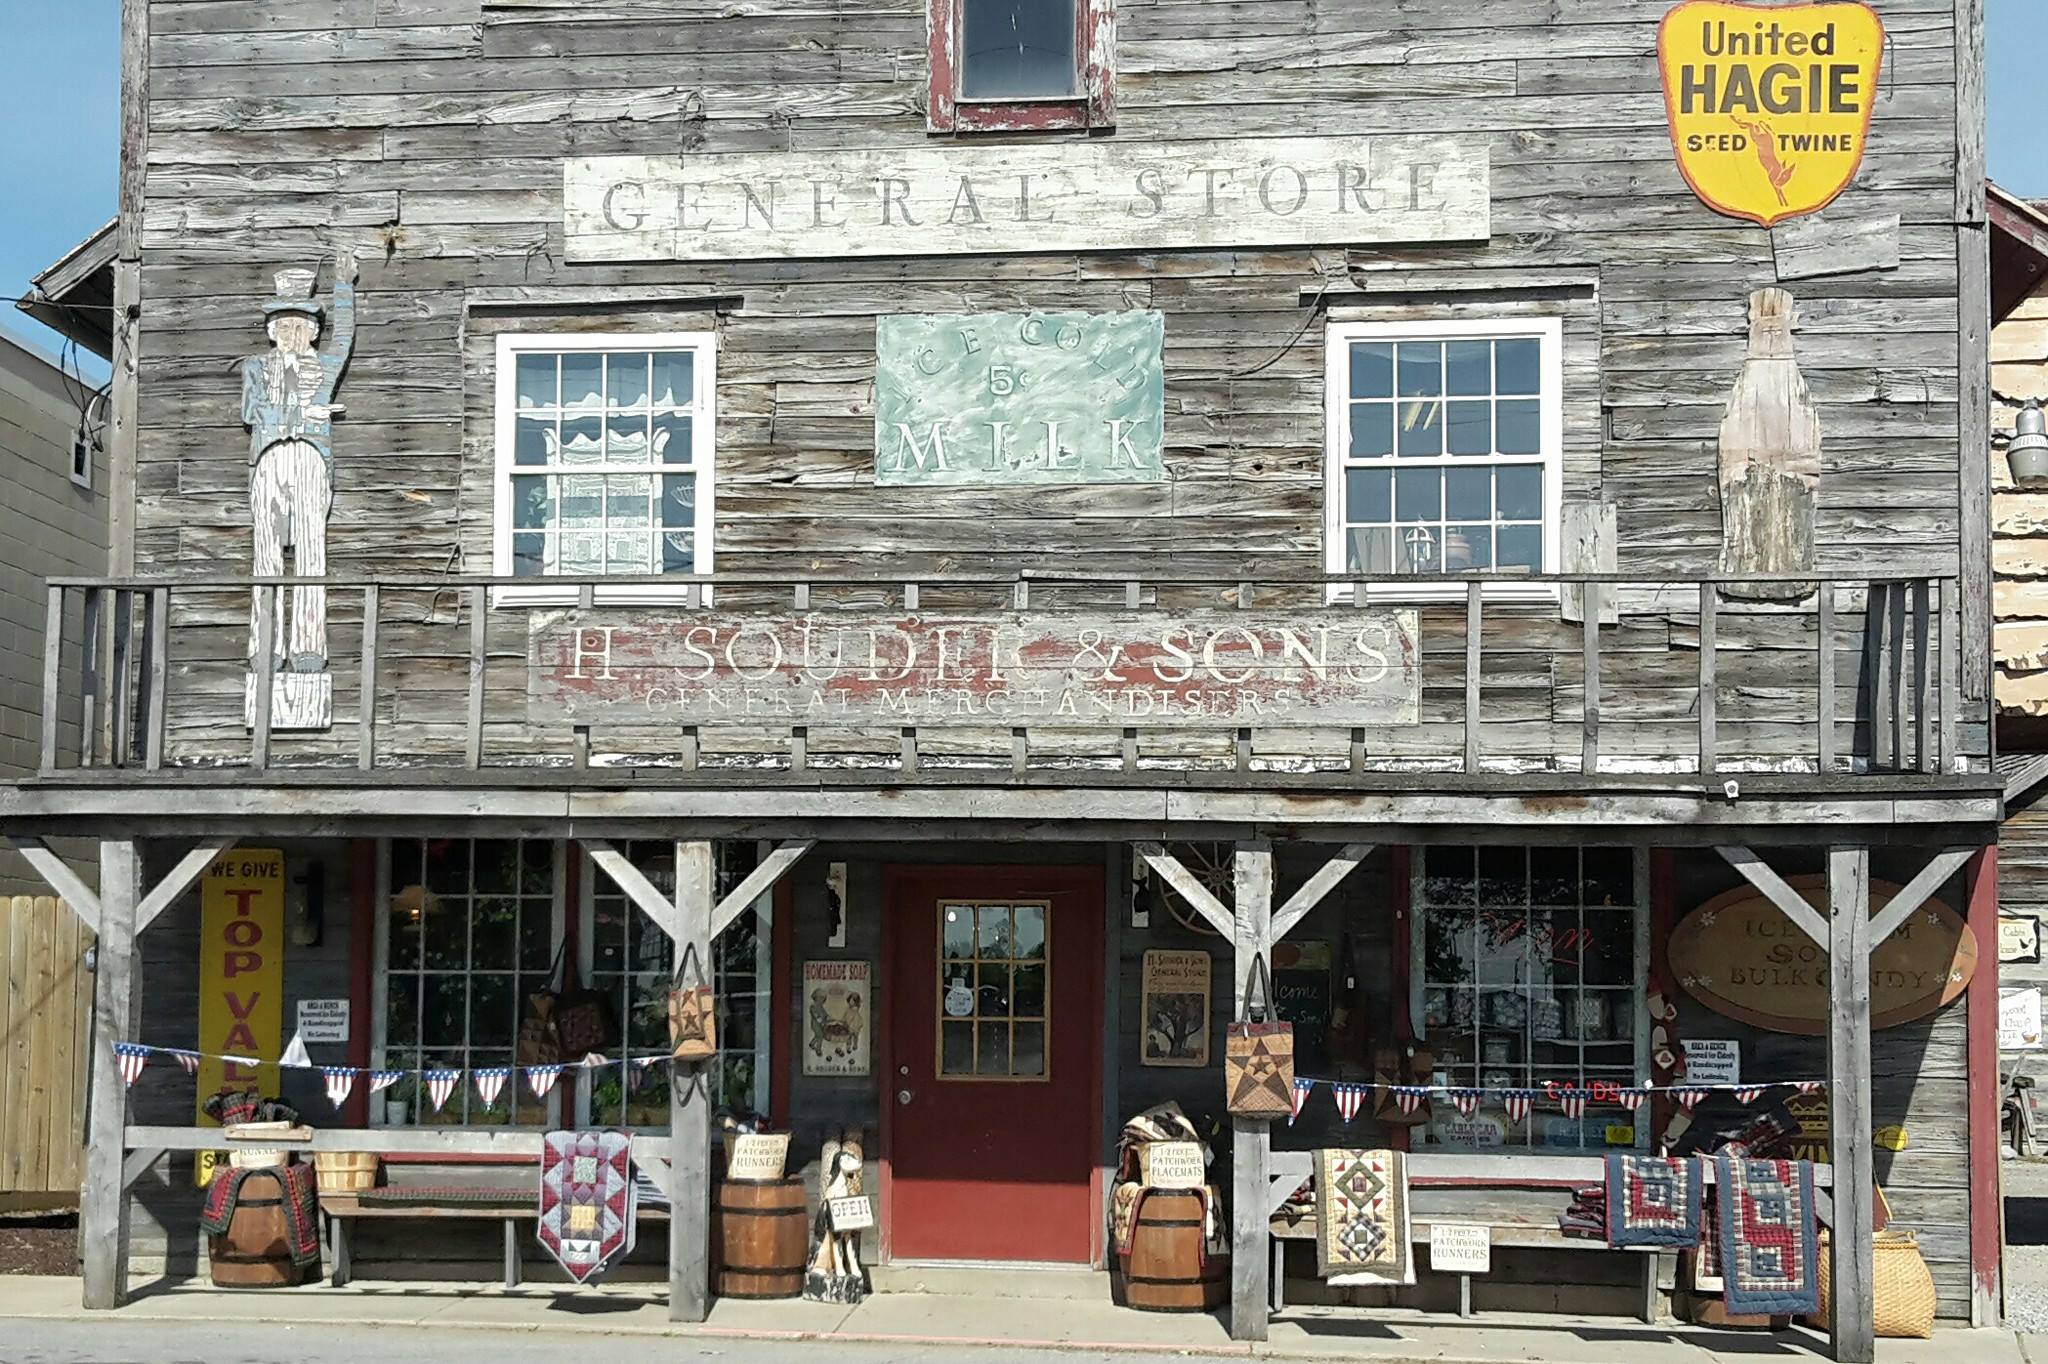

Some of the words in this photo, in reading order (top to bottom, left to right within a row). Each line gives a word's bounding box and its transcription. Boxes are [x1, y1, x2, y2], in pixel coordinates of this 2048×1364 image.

[1702, 21, 1835, 57] United
[1680, 63, 1860, 115] HAGIE
[1687, 134, 1747, 152] SEED
[1778, 134, 1852, 152] TWINE
[602, 173, 1055, 232] GENERAL
[1126, 162, 1447, 219] STORE
[883, 418, 1152, 473] MILK
[1072, 628, 1128, 683] &
[1153, 626, 1392, 684] SONS
[646, 688, 852, 716] GENERAL
[873, 688, 1291, 717] MERCHANDISERS
[212, 861, 235, 877] WE
[241, 861, 279, 878] GIVE
[223, 889, 263, 978] TOP
[1766, 943, 1819, 964] SO
[1730, 967, 1808, 986] BULK
[1815, 968, 1928, 989] CNDY
[1547, 1080, 1621, 1104] CADY
[1152, 1156, 1202, 1166] PATCHWORK
[1152, 1166, 1203, 1177] PLACEMATS
[831, 1199, 869, 1218] OPEN
[1433, 1238, 1487, 1248] PATCHWORK
[1433, 1247, 1488, 1260] RUNNERS
